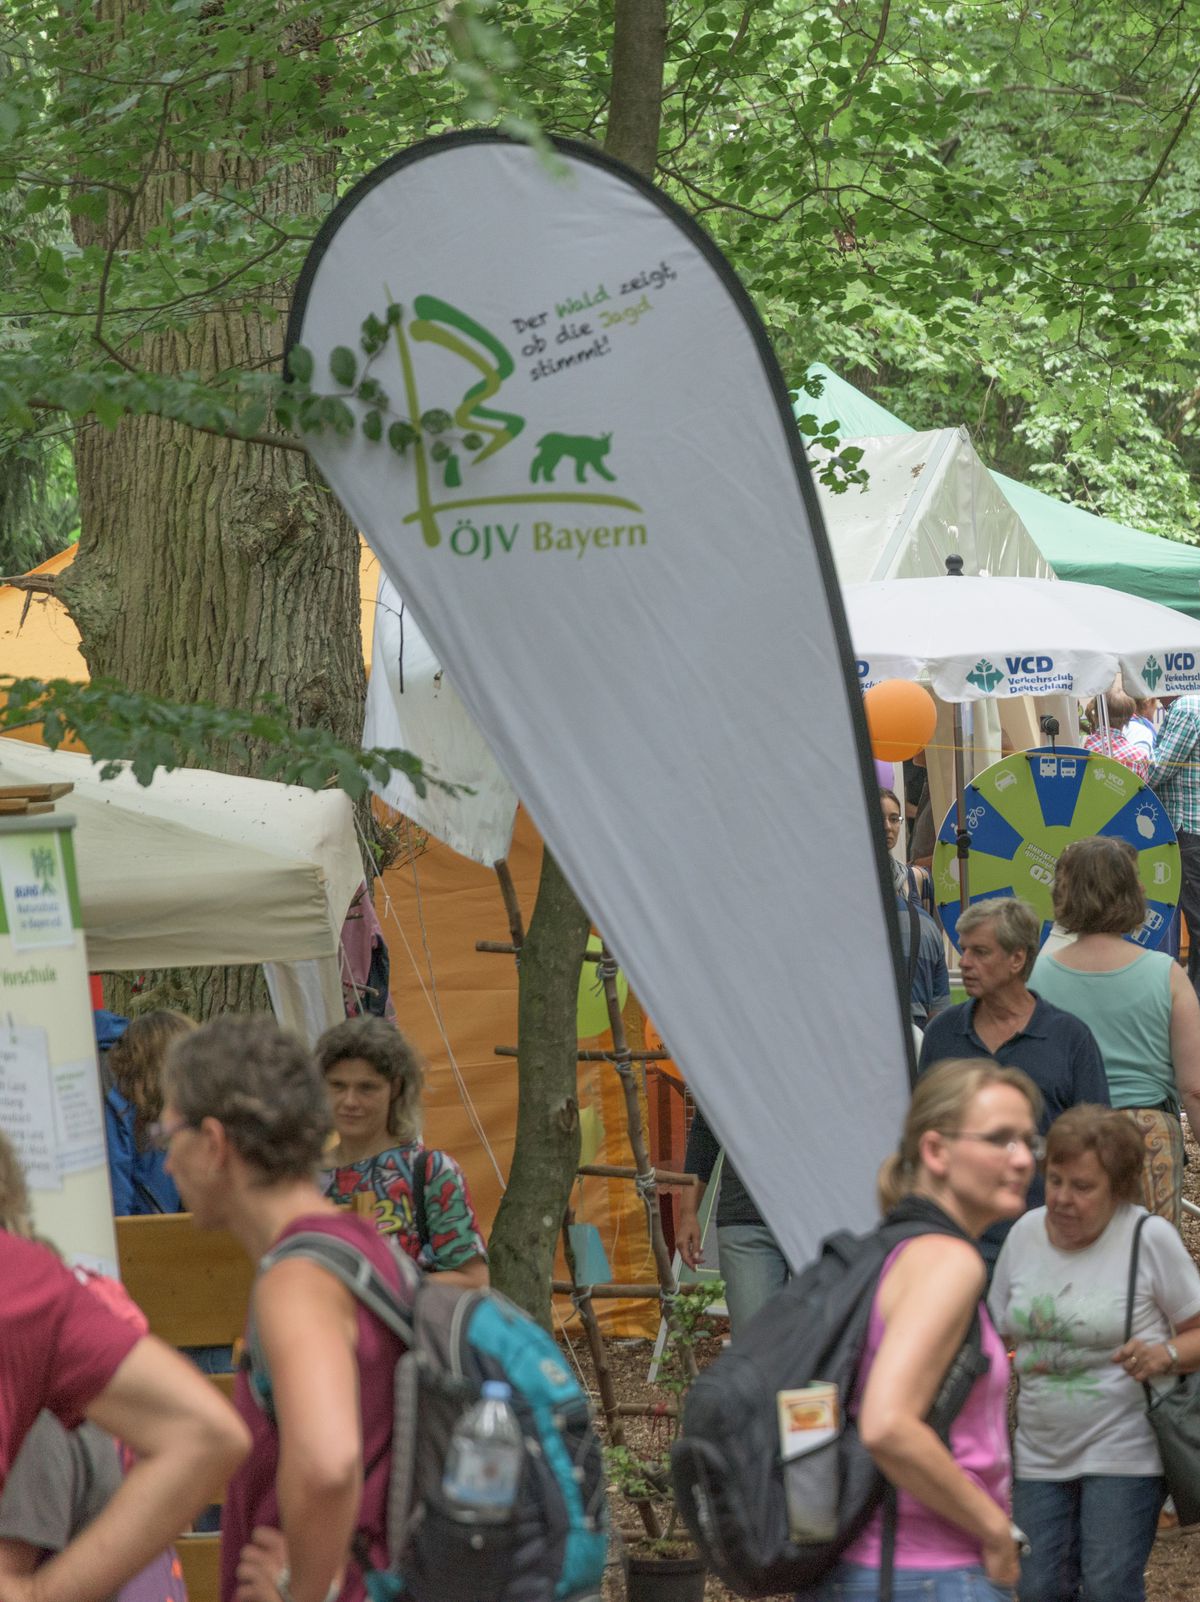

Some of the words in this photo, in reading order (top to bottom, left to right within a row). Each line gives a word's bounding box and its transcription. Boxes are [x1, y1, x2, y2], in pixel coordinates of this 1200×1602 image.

[511, 312, 548, 335] Der
[555, 284, 611, 319] Wald
[619, 261, 678, 295] zeigt,
[521, 334, 548, 357] ob
[556, 323, 593, 345] die
[598, 294, 654, 328] Jagd
[530, 335, 612, 382] stimmt!
[450, 518, 520, 560] ÖJV
[532, 521, 648, 560] Bayern
[1006, 656, 1053, 675] VCD
[1007, 673, 1074, 685] Verkehrsclub
[1164, 653, 1196, 671] VCD
